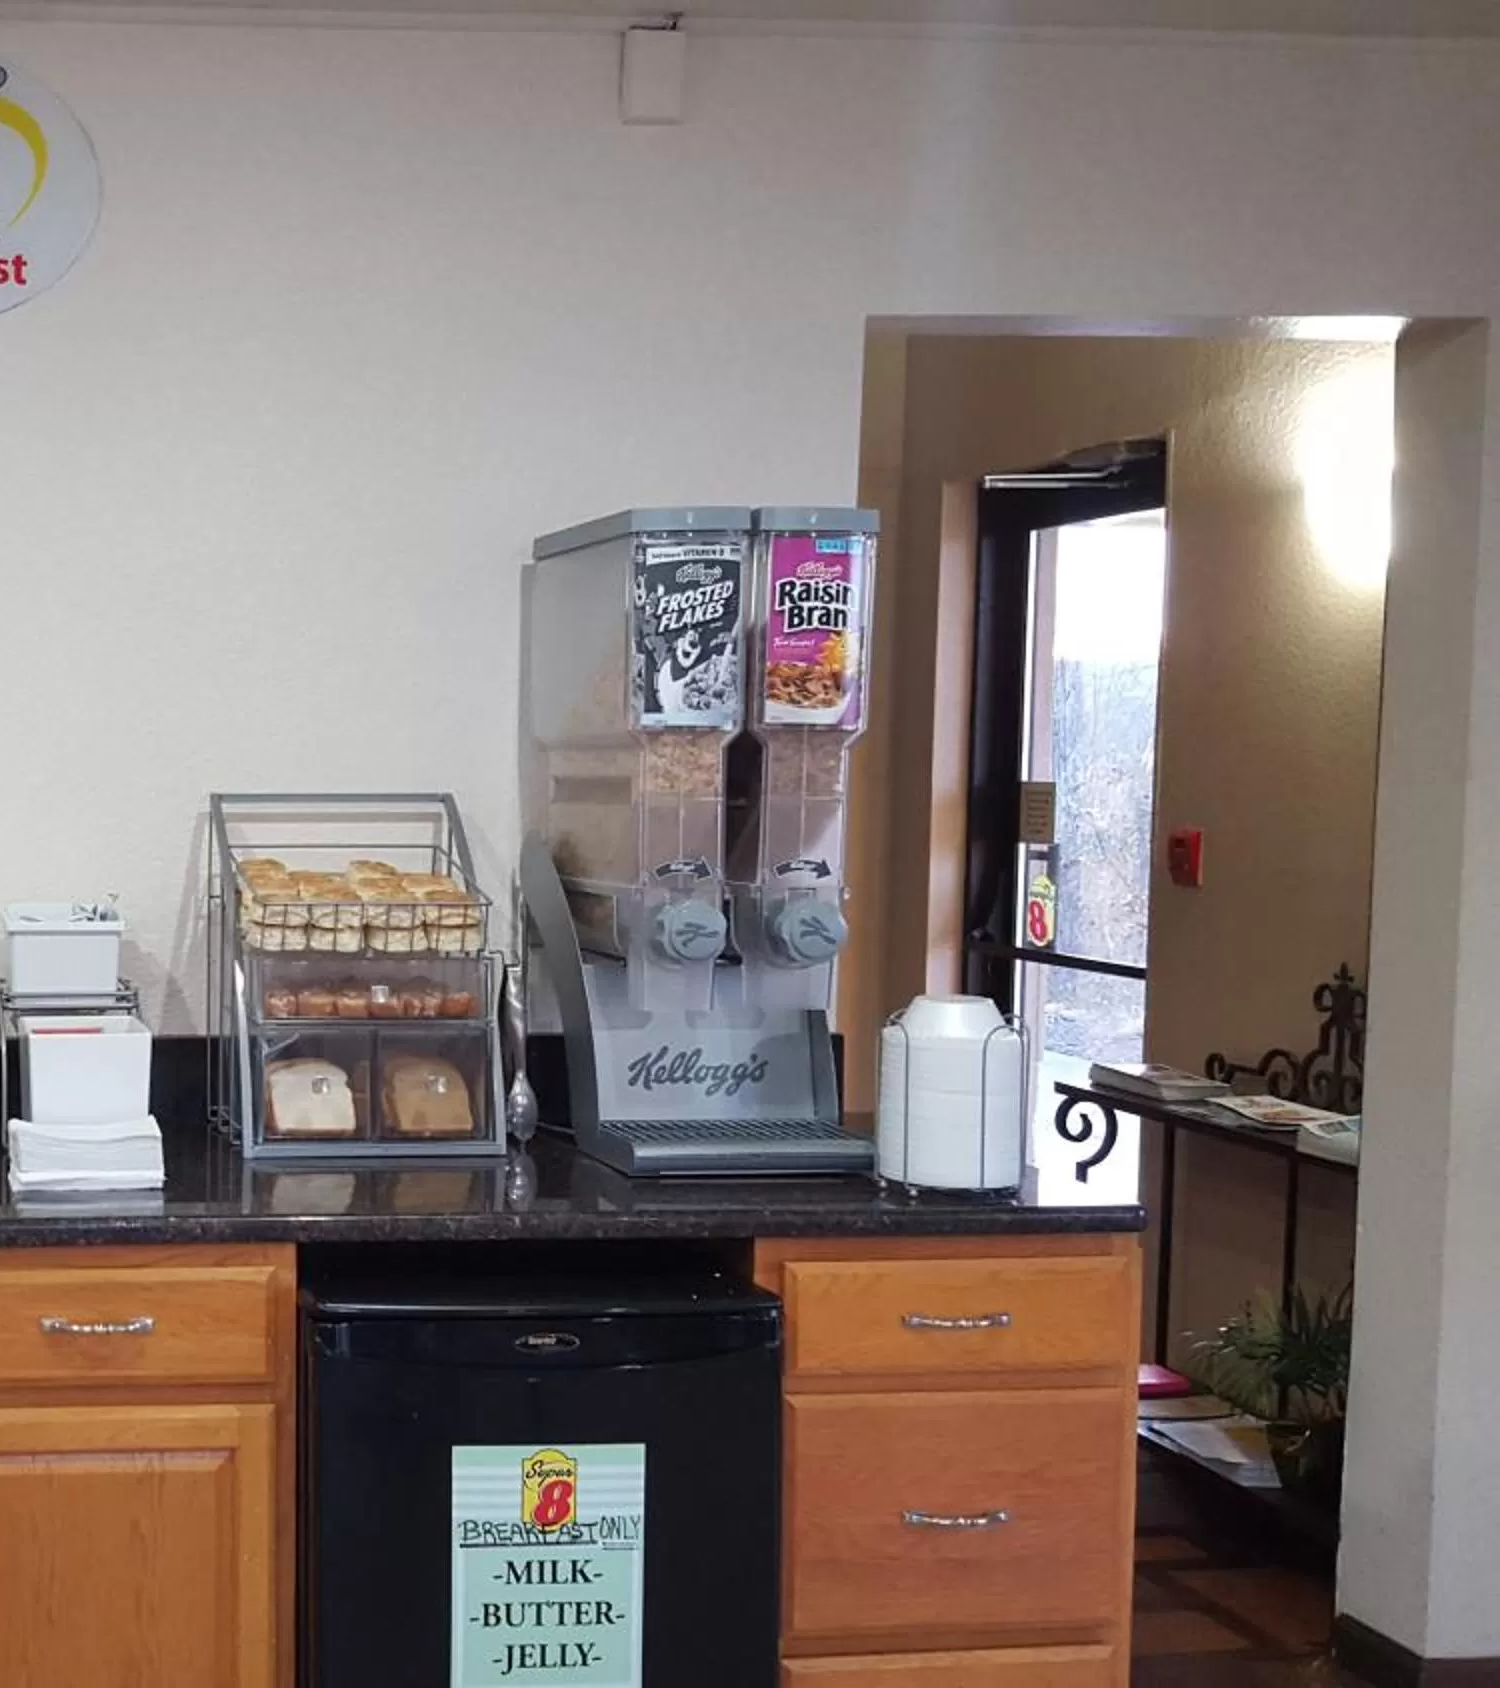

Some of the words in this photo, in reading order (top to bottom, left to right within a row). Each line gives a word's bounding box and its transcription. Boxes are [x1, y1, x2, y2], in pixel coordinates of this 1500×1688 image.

[656, 580, 735, 615] FROSTED
[657, 600, 725, 633] FLAKES
[786, 605, 847, 629] Bran
[628, 1046, 769, 1096] Kellogg's
[525, 1459, 574, 1488] Super
[533, 1478, 575, 1528] 8
[600, 1514, 642, 1541] ONLY
[493, 1559, 604, 1586] -MILK-
[469, 1600, 626, 1628] -BUTTER-
[492, 1643, 603, 1675] -JELLY-
